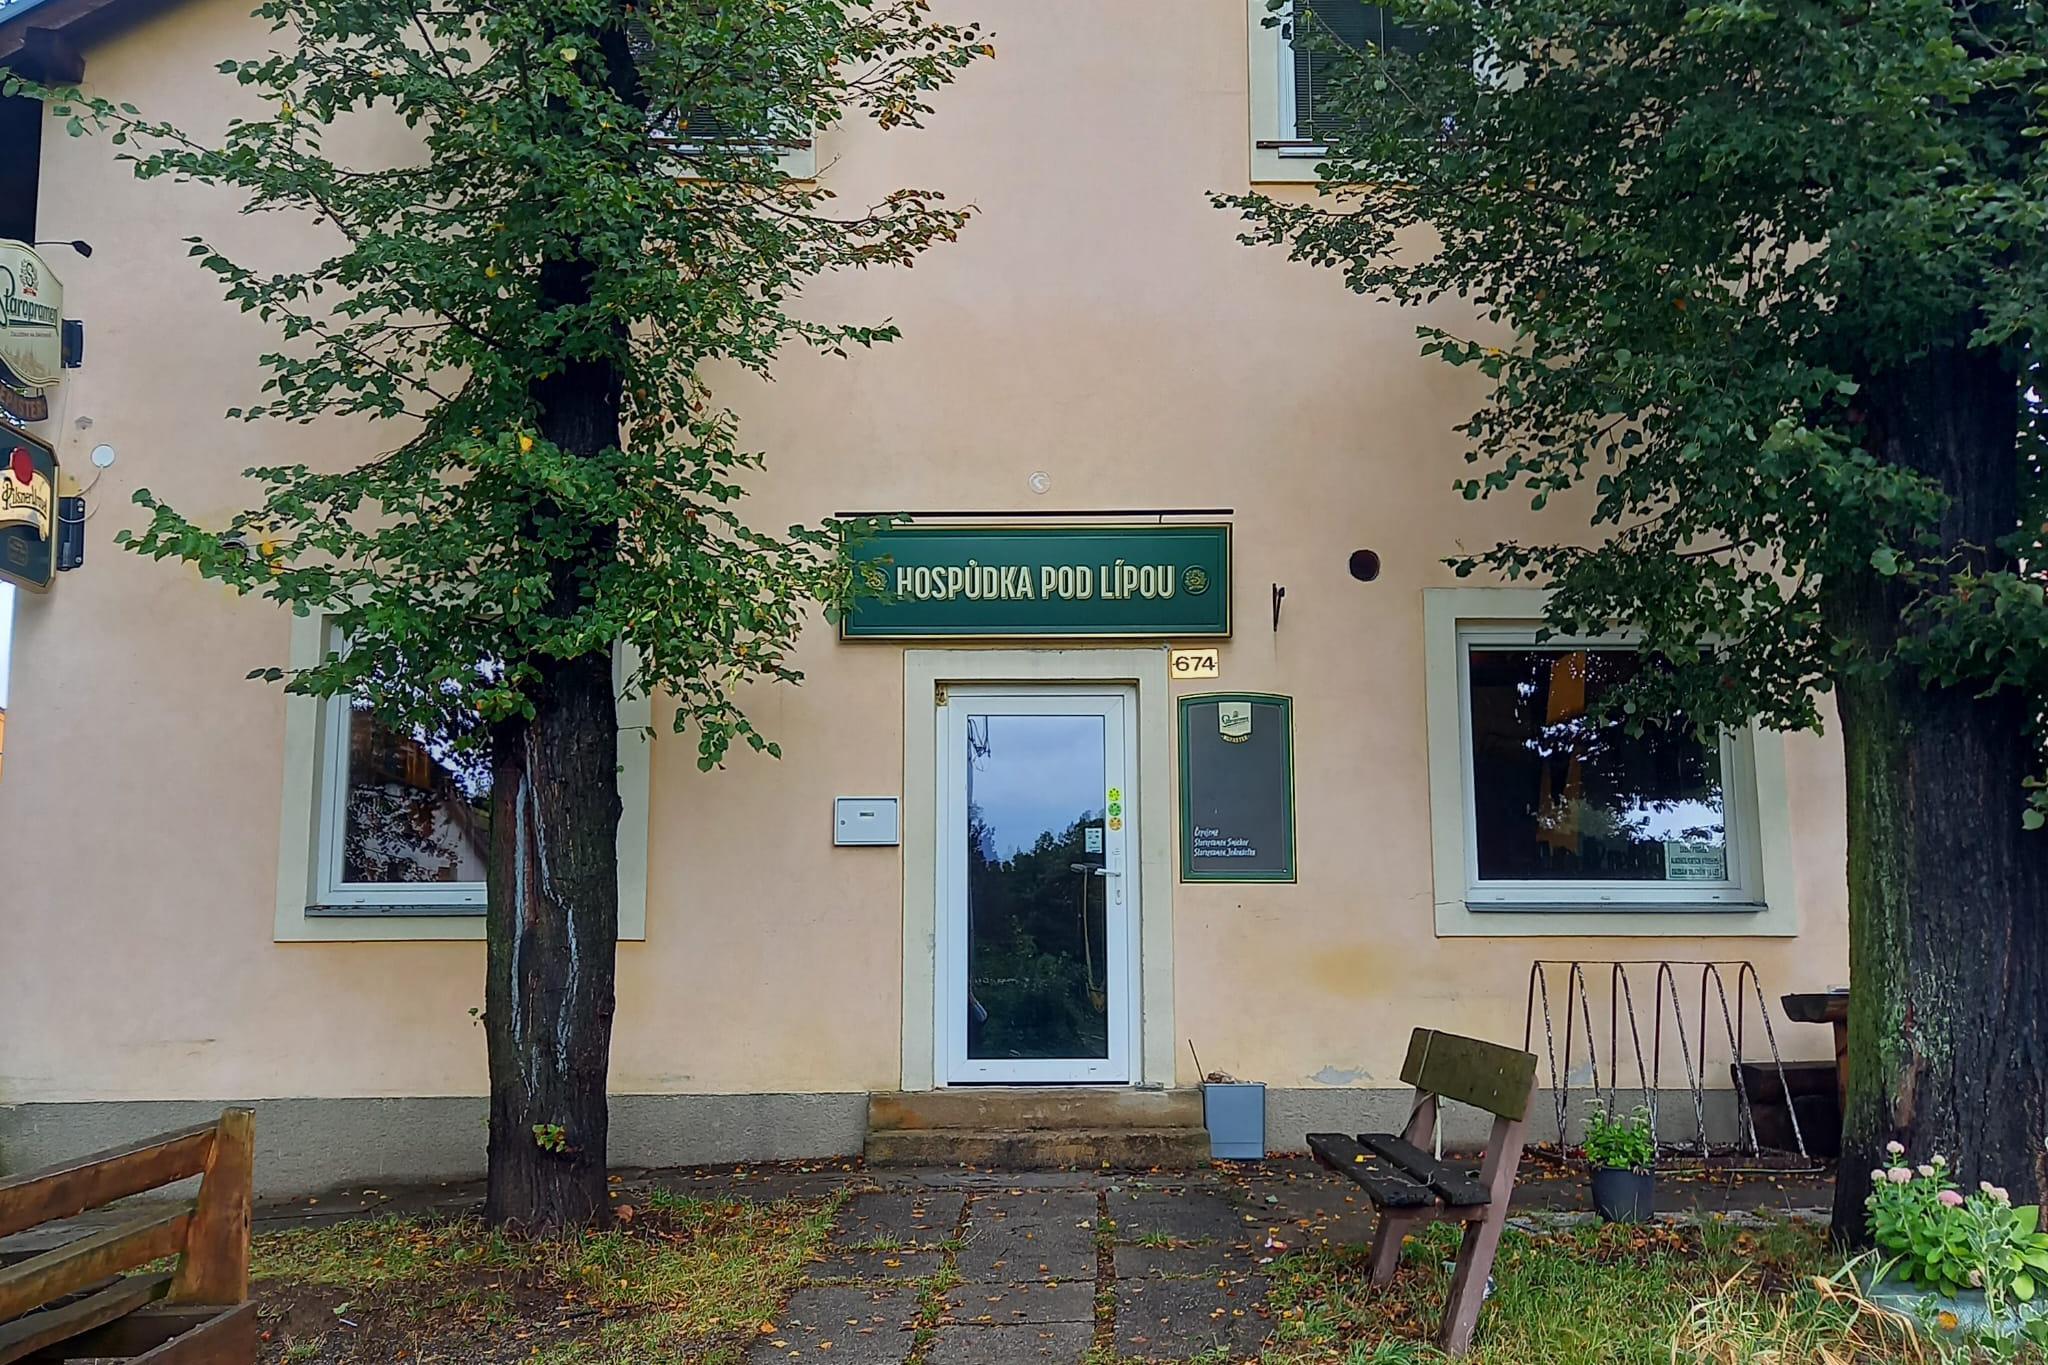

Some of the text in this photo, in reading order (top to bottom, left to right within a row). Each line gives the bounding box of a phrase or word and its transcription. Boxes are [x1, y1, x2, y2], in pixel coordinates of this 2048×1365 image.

[897, 559, 1035, 600] HOSPŮDKA
[1041, 566, 1094, 600] POD
[1101, 559, 1176, 600] LÍPOU
[1175, 656, 1216, 671] 674
